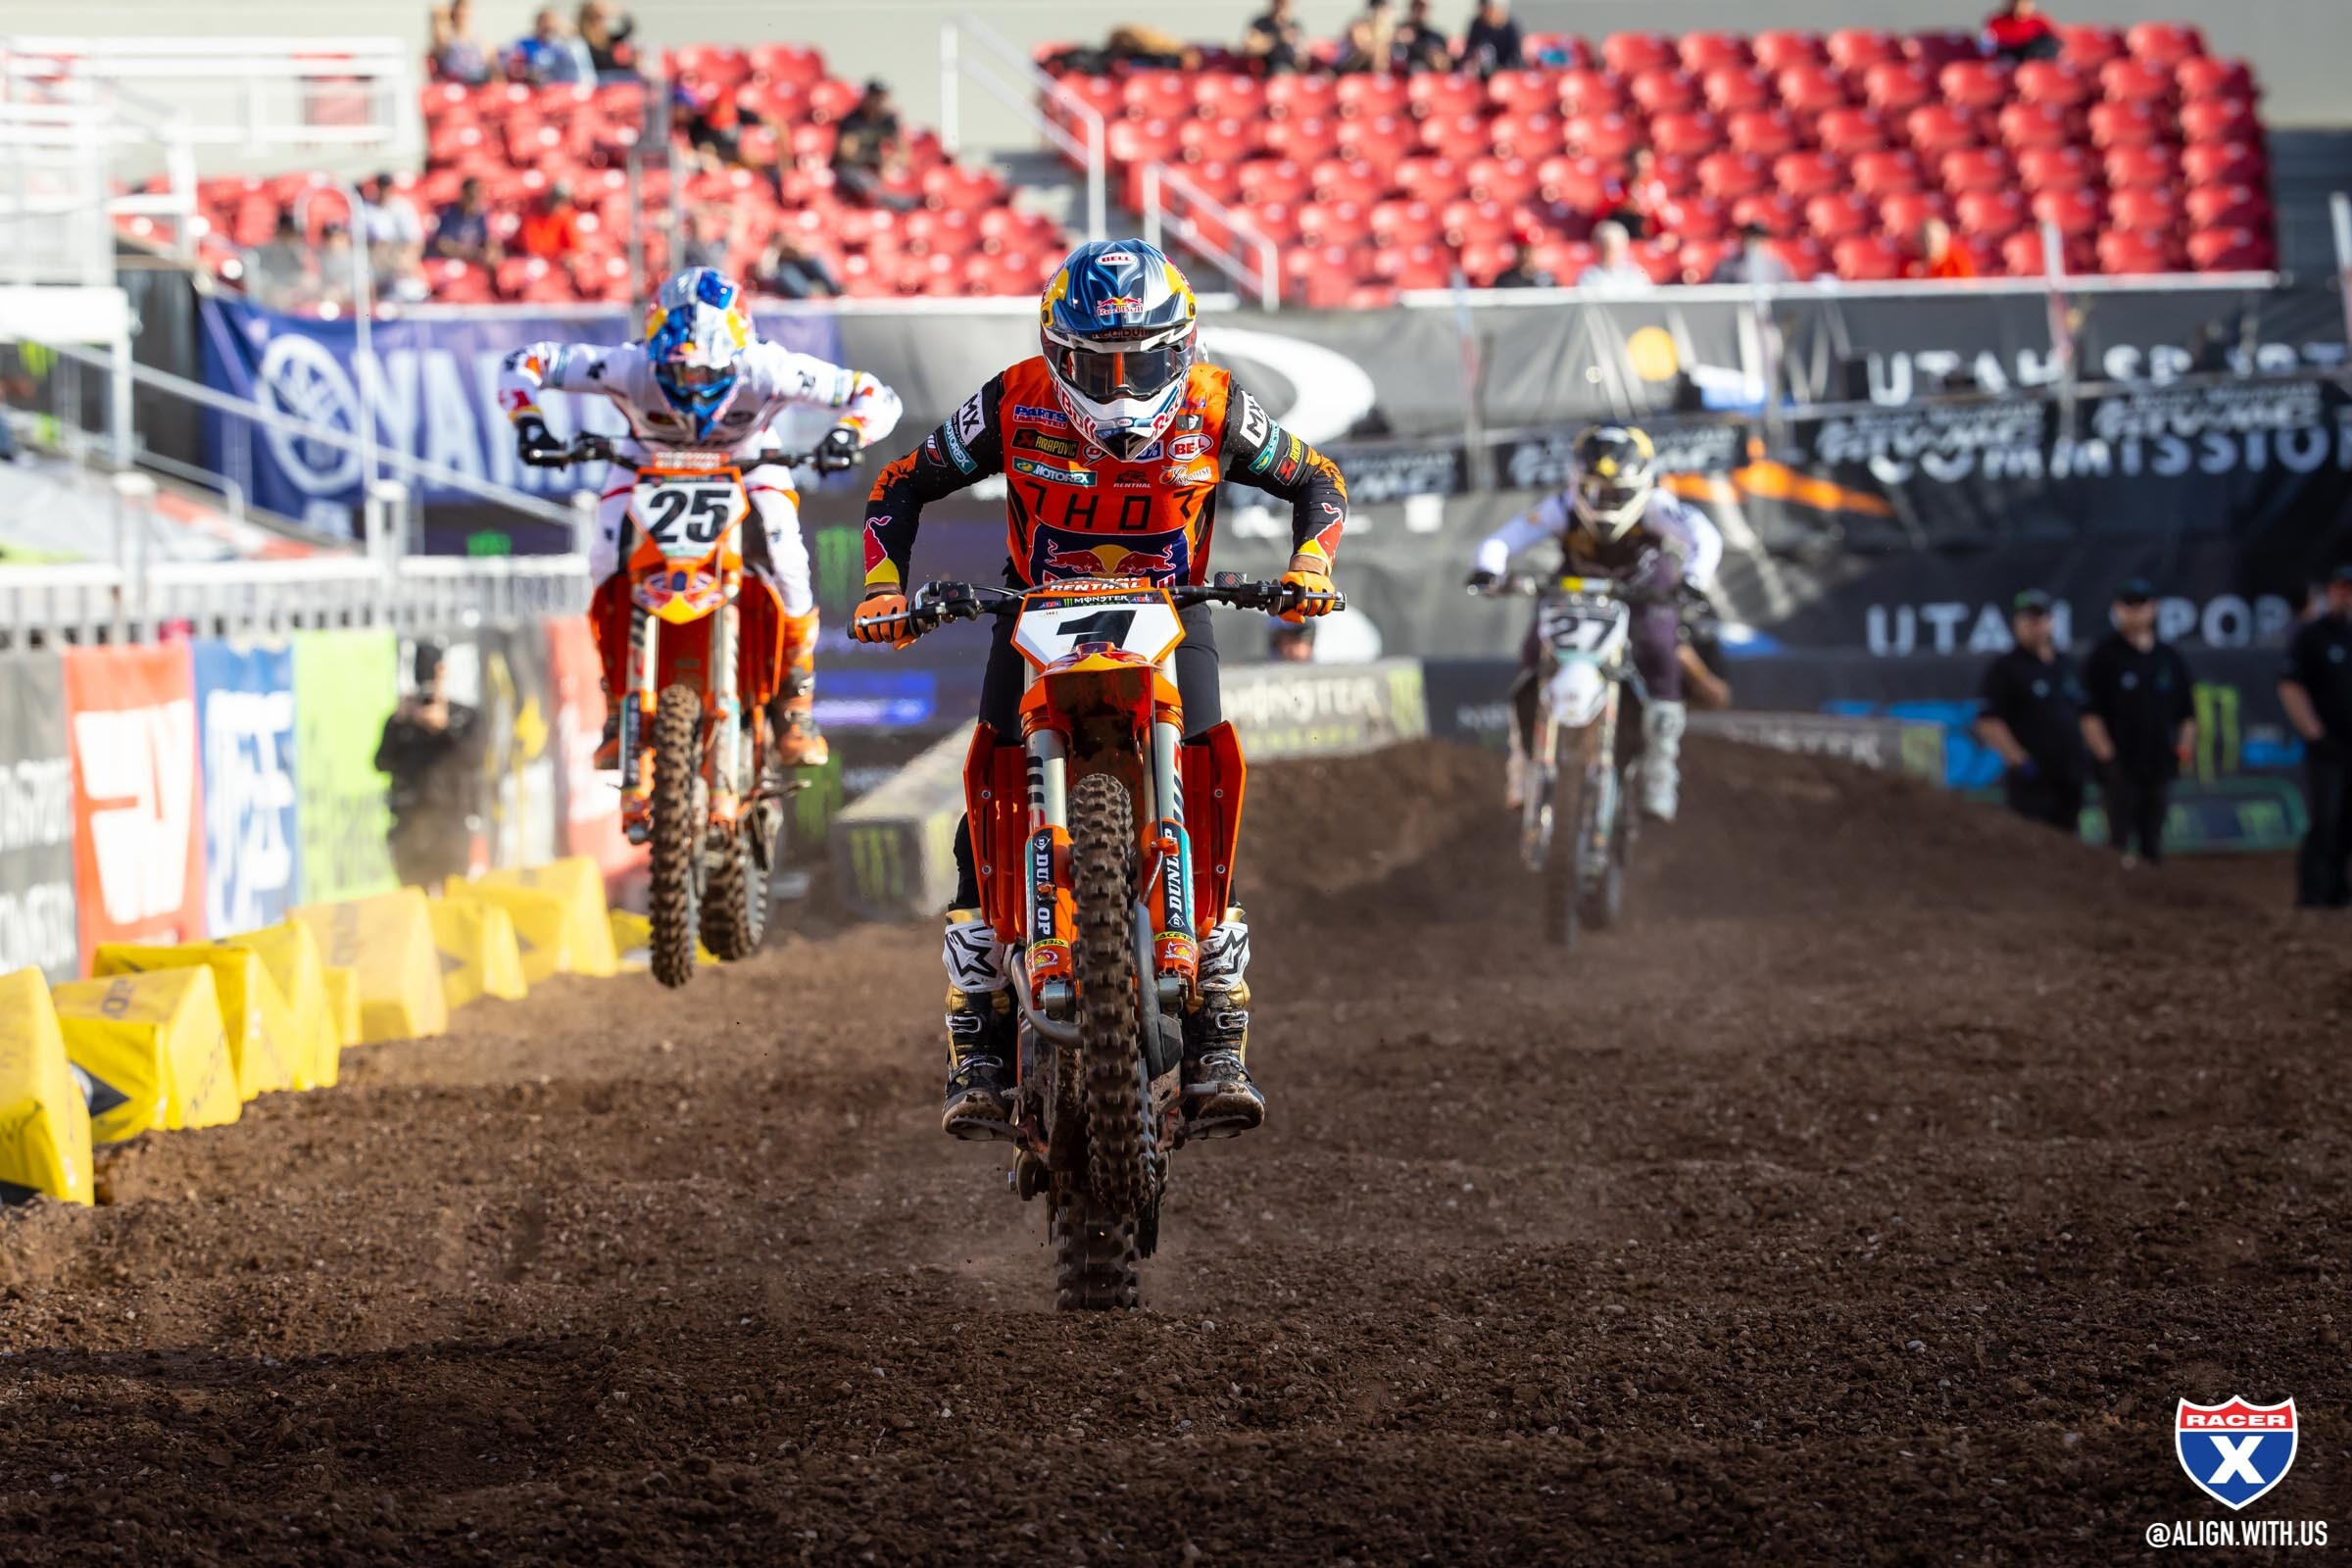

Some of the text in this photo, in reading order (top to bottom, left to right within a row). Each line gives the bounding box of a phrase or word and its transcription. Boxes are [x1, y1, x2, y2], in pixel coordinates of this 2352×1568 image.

[1102, 255, 1132, 264] BELL
[1098, 305, 1144, 316] Red Bull
[1014, 405, 1067, 423] PARTS
[945, 419, 970, 468] MOTOREX
[1033, 464, 1091, 484] MOTOREX
[649, 490, 731, 543] 25
[1074, 595, 1129, 605] MONSTER
[1055, 610, 1138, 650] 1
[1549, 615, 1617, 651] 27
[1036, 854, 1052, 936] DUOP
